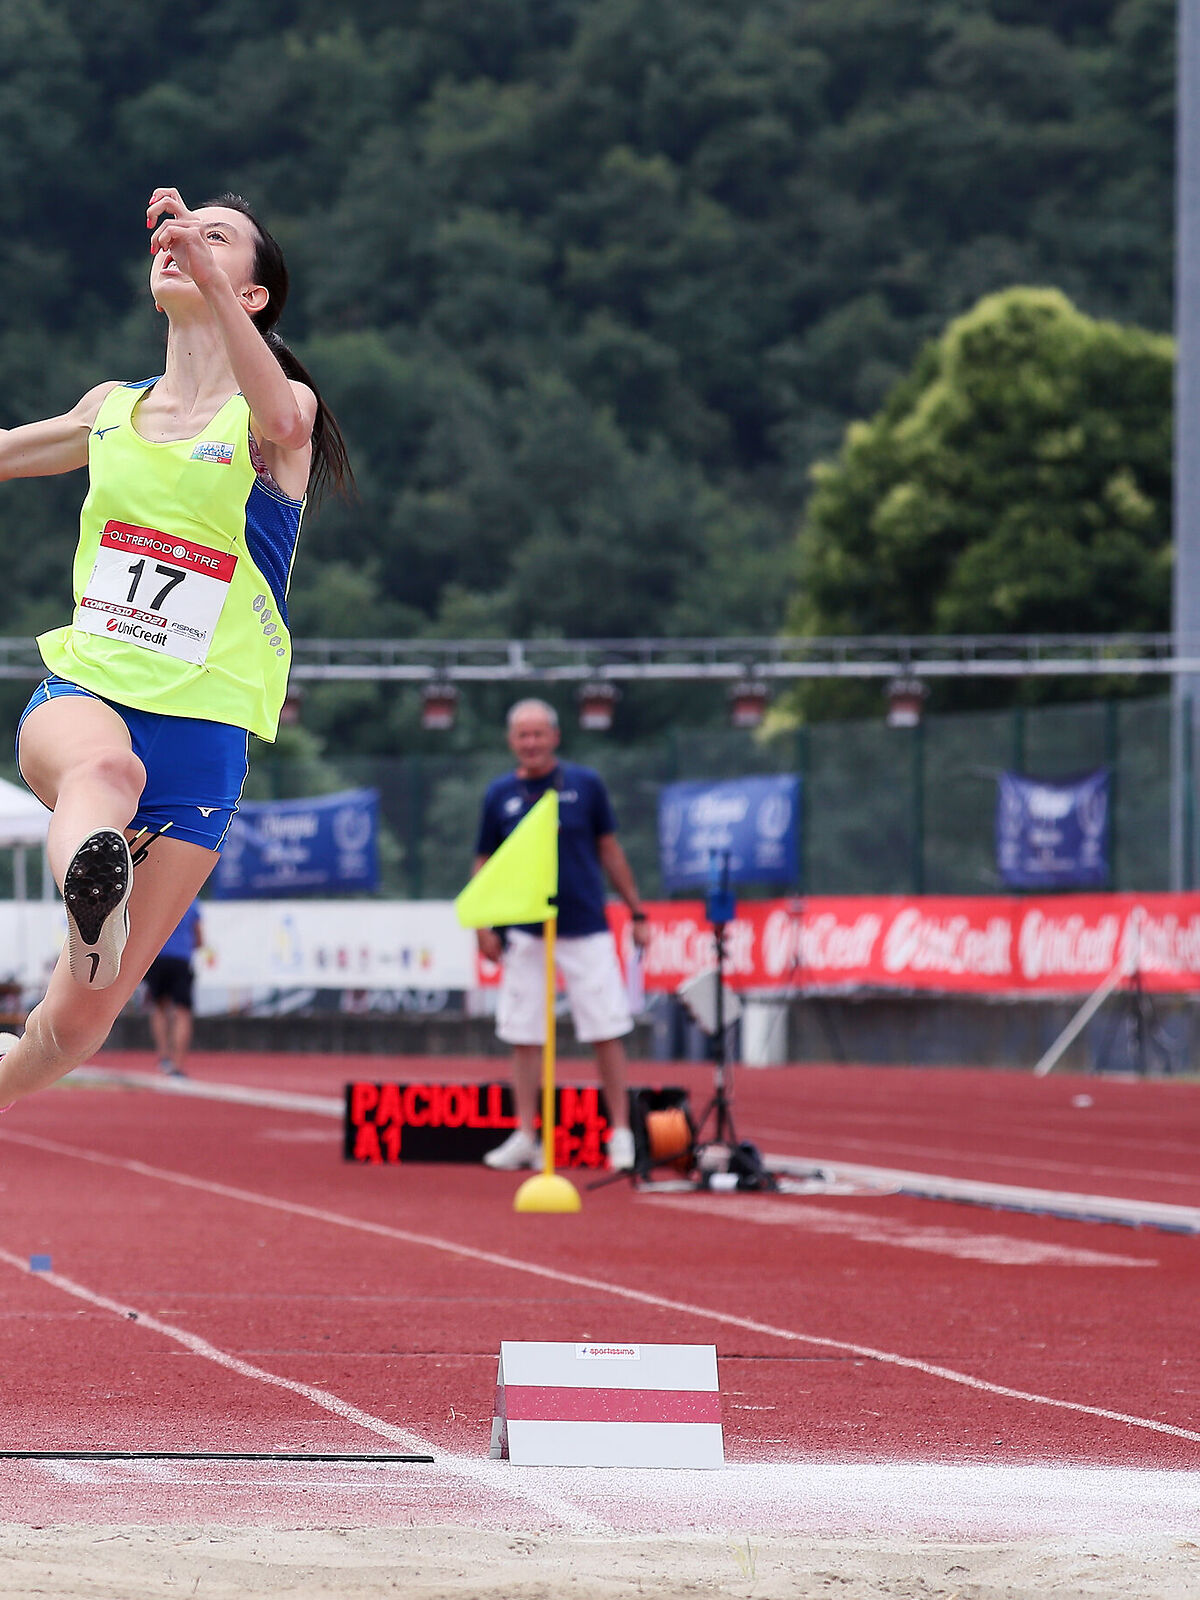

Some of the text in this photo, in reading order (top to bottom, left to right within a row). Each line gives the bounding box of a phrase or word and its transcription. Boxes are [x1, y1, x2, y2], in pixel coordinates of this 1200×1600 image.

[127, 559, 187, 611] 17
[85, 599, 166, 627] CONCESIO 2021
[117, 621, 168, 646] UniCredit
[352, 1082, 542, 1129] PACIOLL
[589, 1347, 635, 1356] sportissimo
